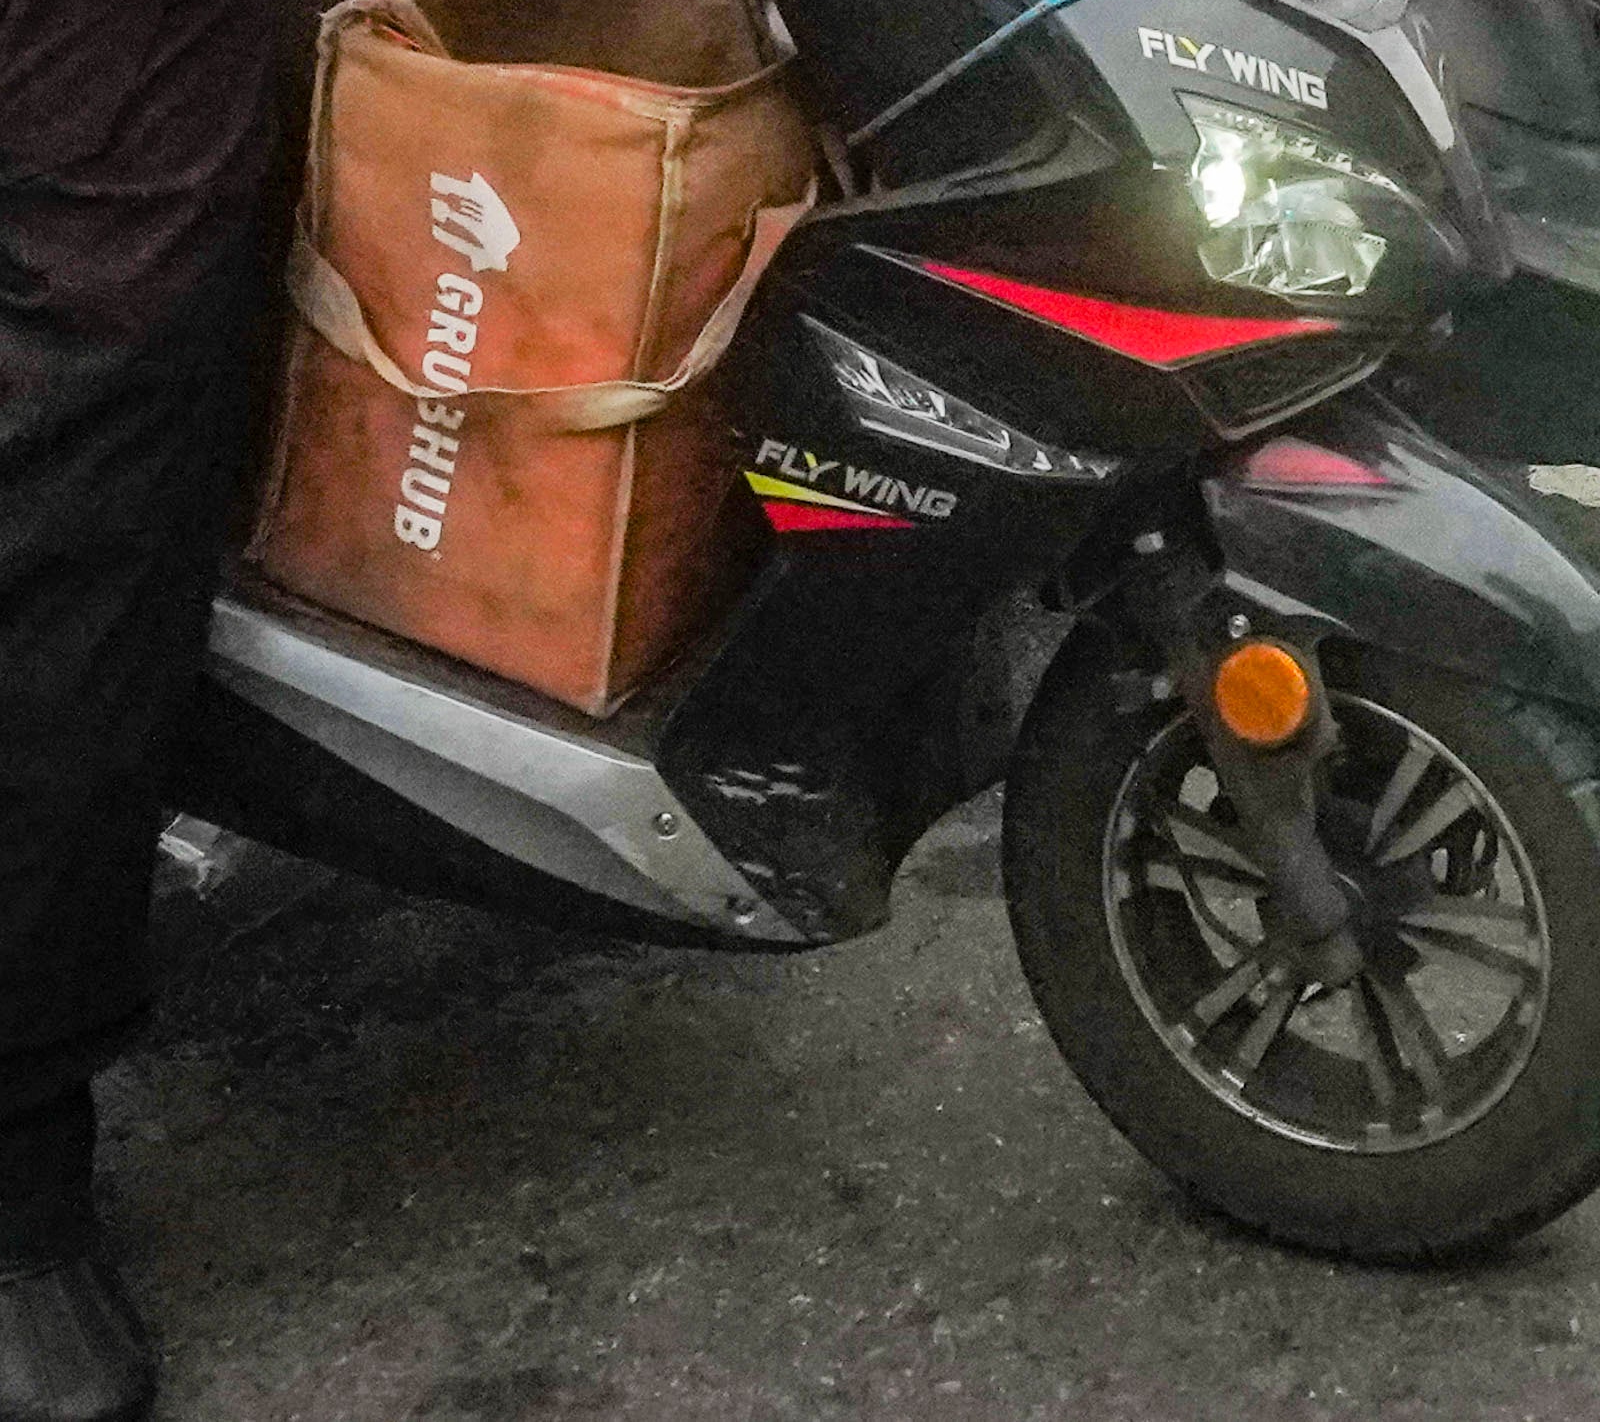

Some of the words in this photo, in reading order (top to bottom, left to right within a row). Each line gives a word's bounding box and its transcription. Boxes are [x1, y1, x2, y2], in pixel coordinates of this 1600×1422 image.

[1137, 26, 1218, 73] FLY
[1222, 48, 1329, 110] WING
[394, 272, 484, 551] GRUBHUB
[754, 438, 841, 483] FLY
[844, 465, 958, 518] WING
